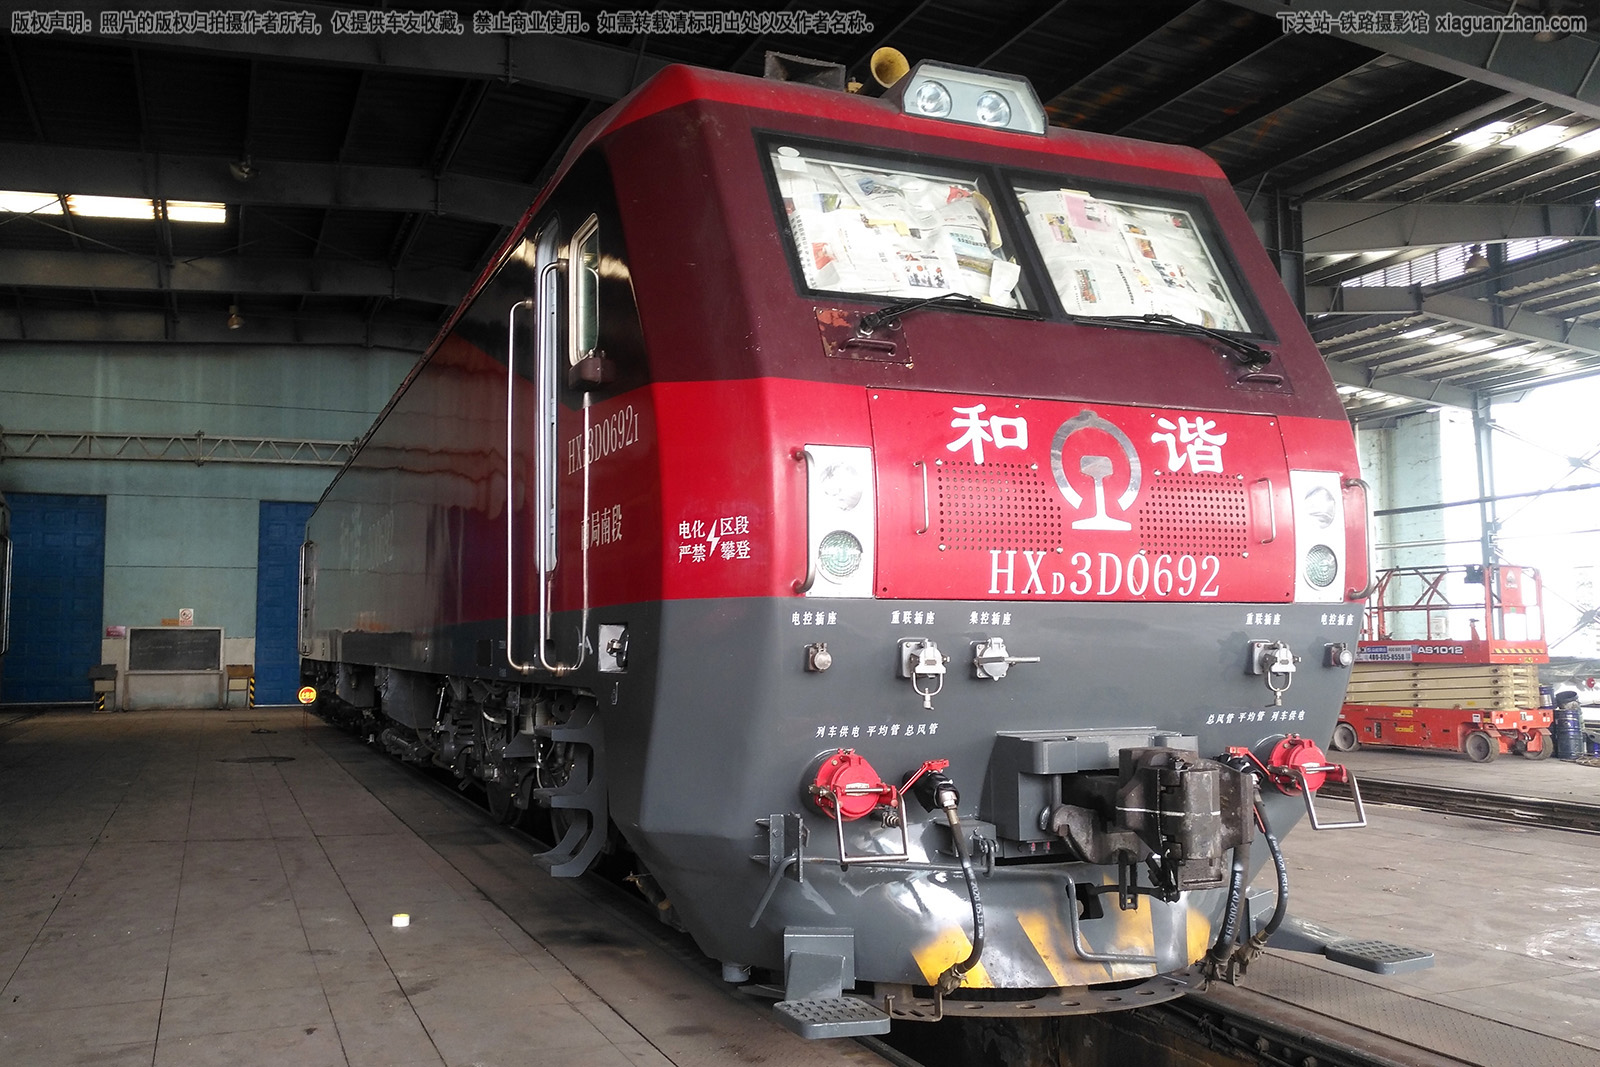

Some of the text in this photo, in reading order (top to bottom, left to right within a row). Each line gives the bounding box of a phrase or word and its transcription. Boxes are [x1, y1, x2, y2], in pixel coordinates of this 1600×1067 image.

[947, 403, 1228, 474] 和 谐
[678, 515, 750, 540] 电化 区段
[678, 539, 751, 563] 严禁 攀登
[988, 549, 1221, 597] HXD3D0692
[791, 611, 838, 626] 电控插座
[891, 610, 936, 626] 重联插座
[1417, 645, 1464, 655] AS1012
[815, 722, 939, 738] 列车供电 平均管 总风管
[970, 881, 981, 901] 2020
